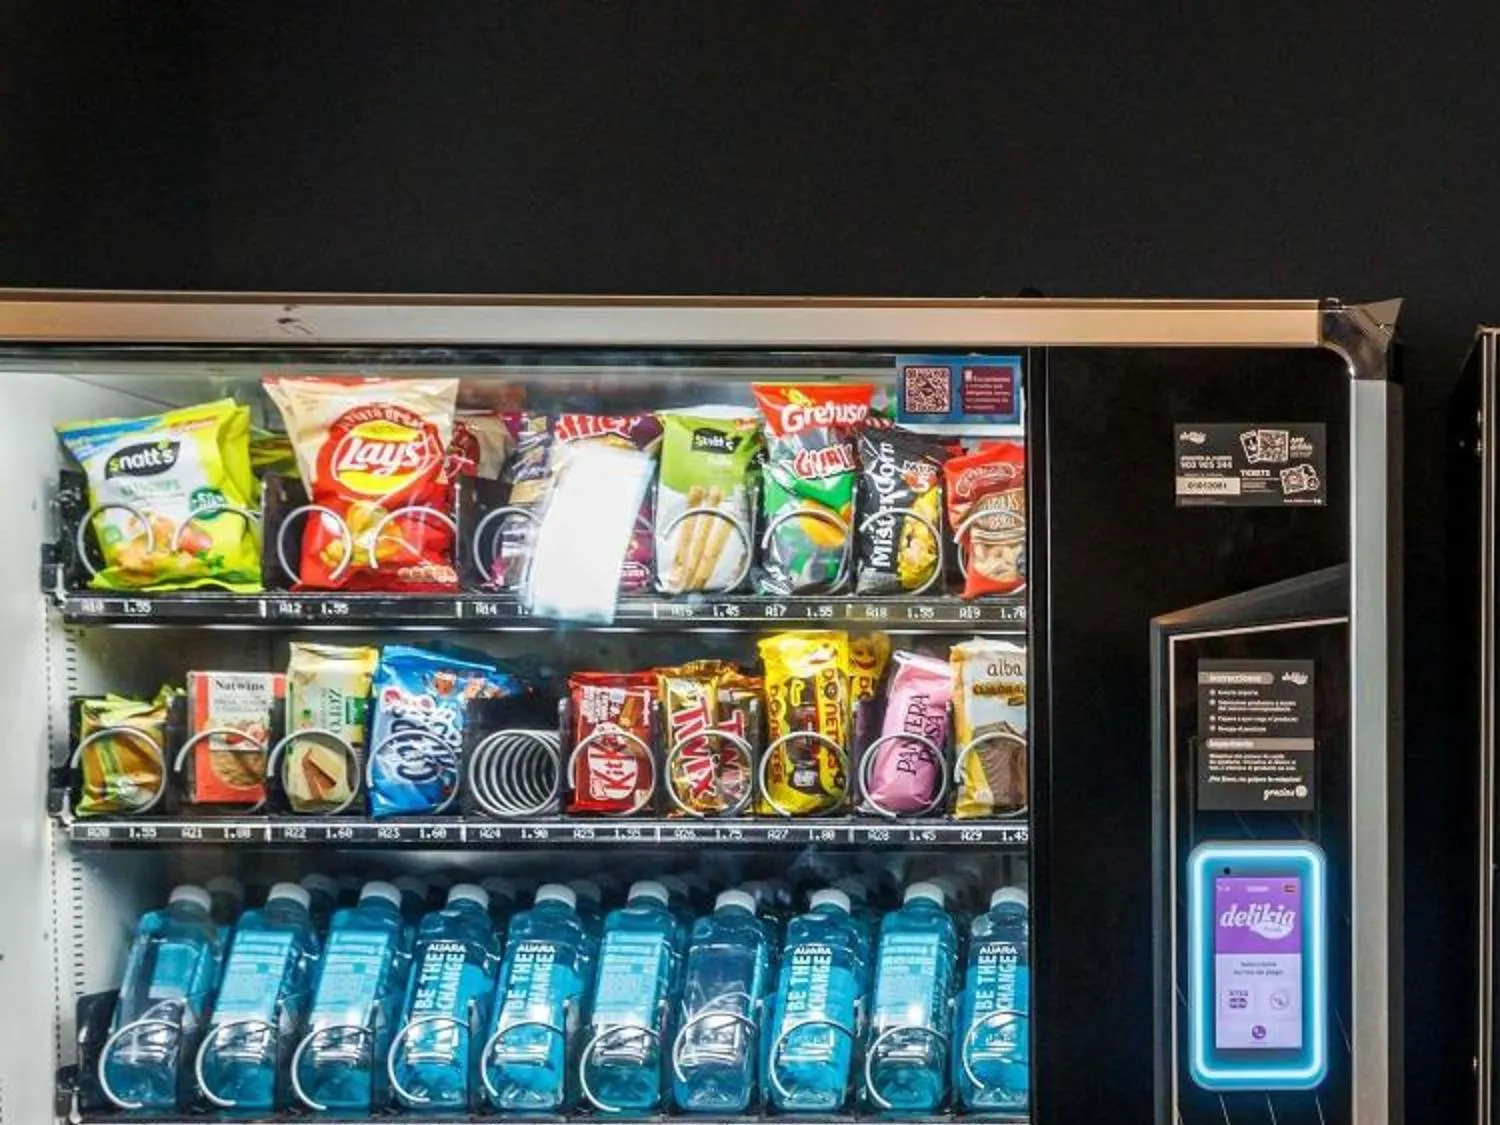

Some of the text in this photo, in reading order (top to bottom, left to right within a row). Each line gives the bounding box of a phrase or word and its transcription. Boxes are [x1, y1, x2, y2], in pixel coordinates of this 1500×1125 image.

[338, 436, 424, 475] Lay's
[765, 606, 787, 616] A17
[959, 607, 981, 618] A19
[767, 829, 788, 840] A27
[1220, 903, 1297, 928] delikia
[420, 953, 444, 986] THE
[510, 953, 534, 986] THE
[791, 955, 811, 985] THE
[977, 955, 997, 985] THE
